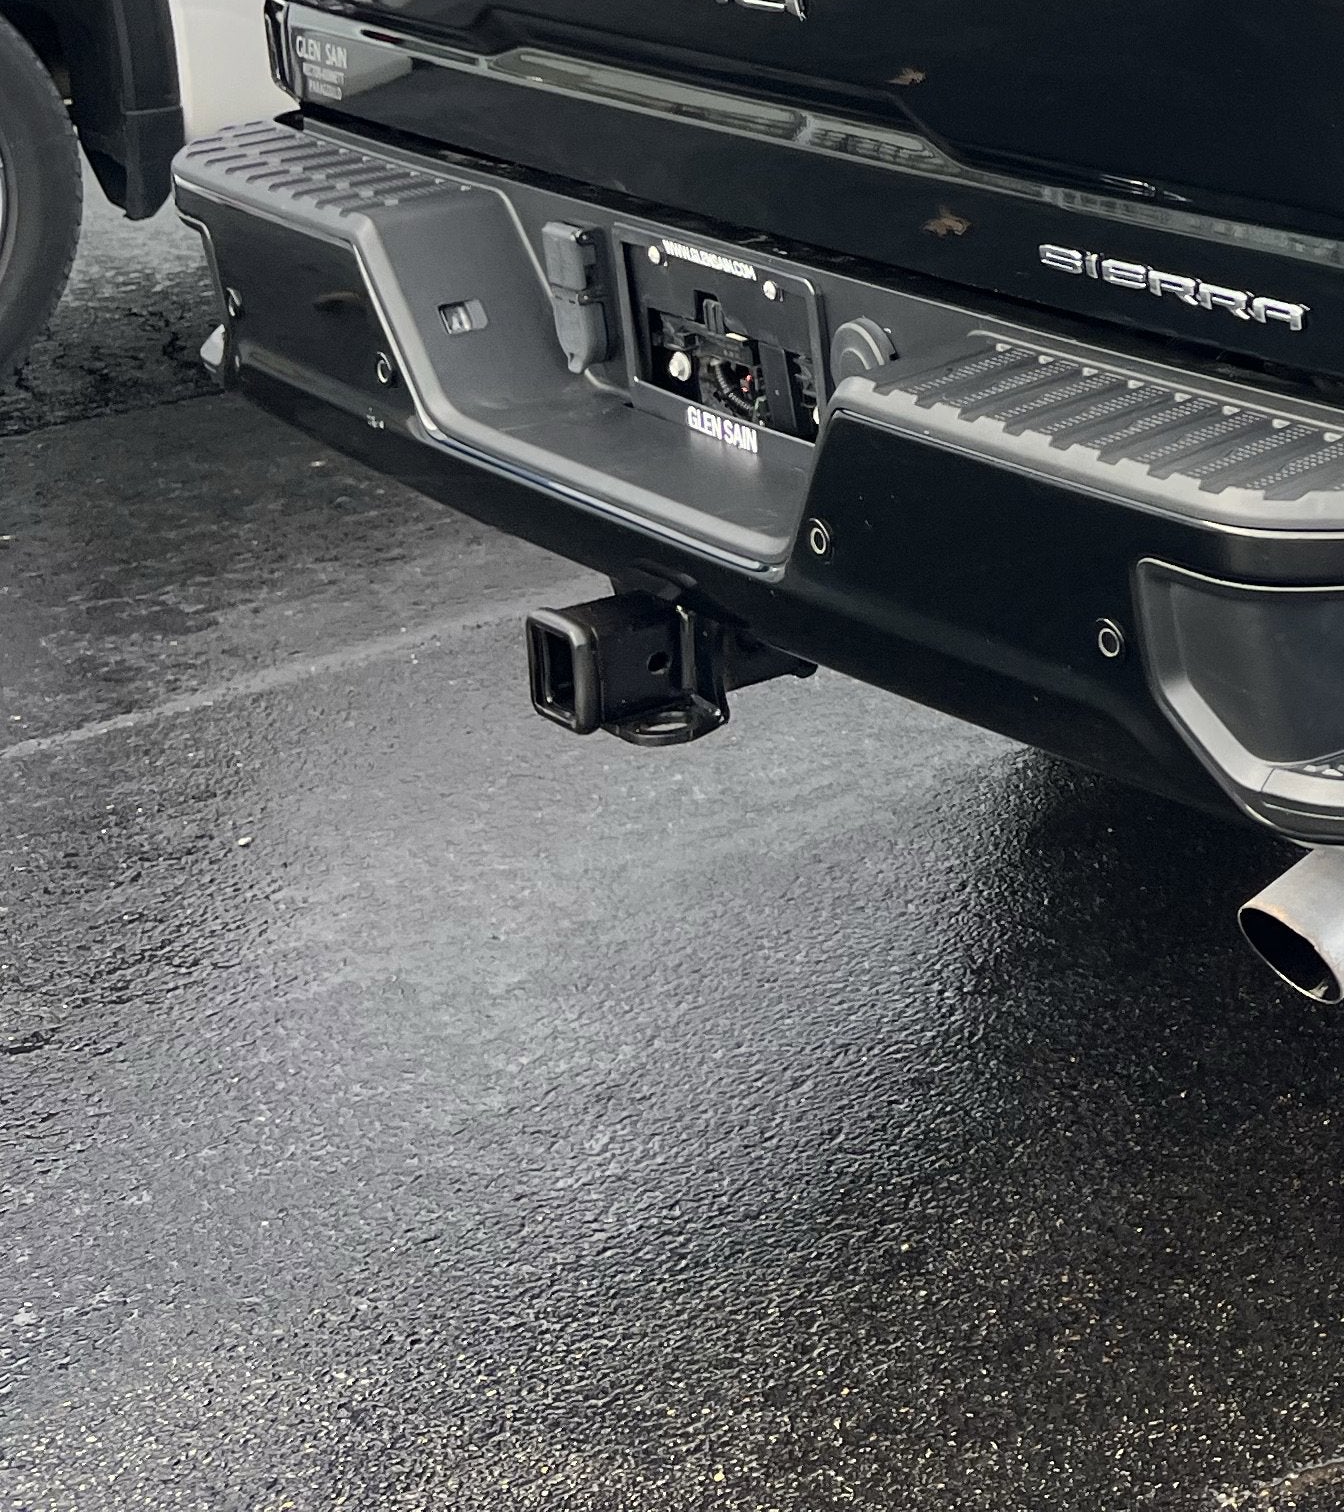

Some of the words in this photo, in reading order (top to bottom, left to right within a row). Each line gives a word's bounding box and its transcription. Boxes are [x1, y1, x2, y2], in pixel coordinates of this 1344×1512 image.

[296, 36, 321, 62] GLEN
[324, 43, 347, 69] SAIN
[1038, 244, 1308, 331] SIERRA
[687, 405, 722, 441] GLEN
[723, 419, 758, 454] SAIN
